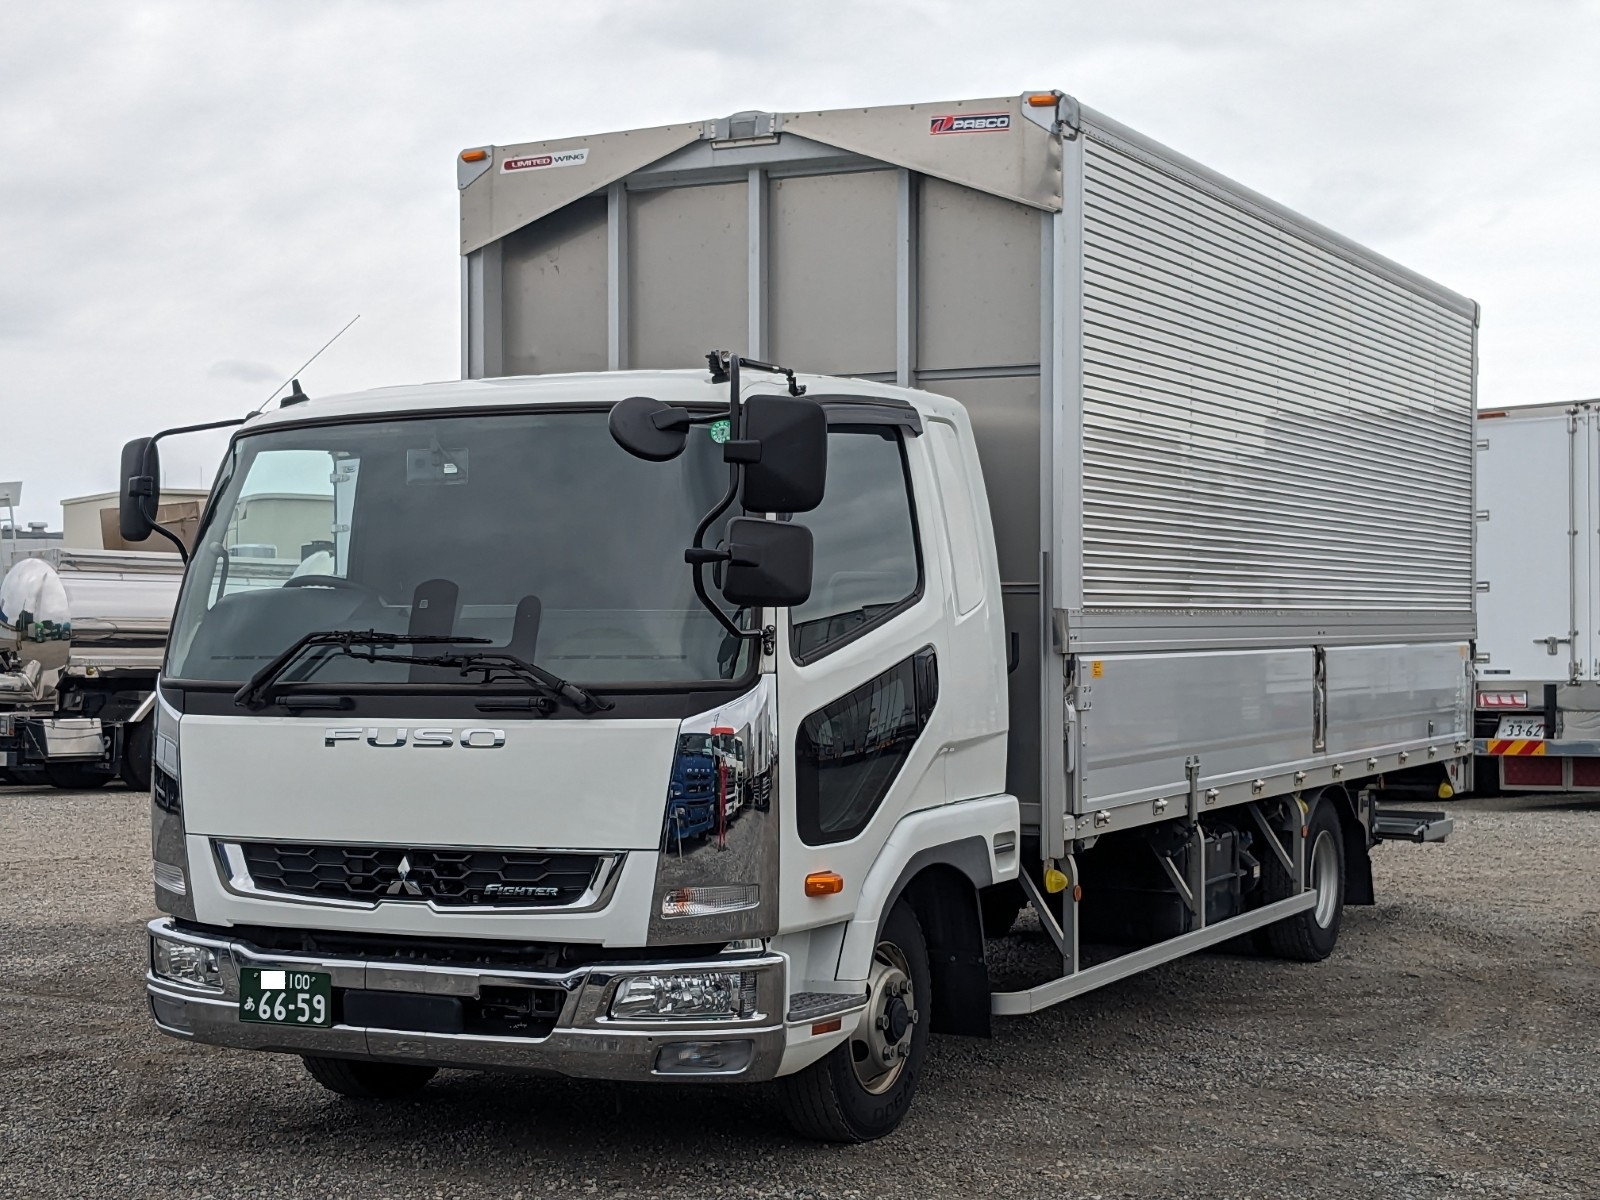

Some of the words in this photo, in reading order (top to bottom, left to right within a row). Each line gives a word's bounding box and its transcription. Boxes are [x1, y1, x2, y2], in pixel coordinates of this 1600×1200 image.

[952, 117, 1009, 130] PABCO
[511, 158, 550, 168] LIMITED
[554, 153, 584, 163] WING
[324, 727, 506, 749] FUSO
[289, 973, 310, 990] 100
[243, 996, 256, 1012] あ
[258, 990, 326, 1024] 66-59
